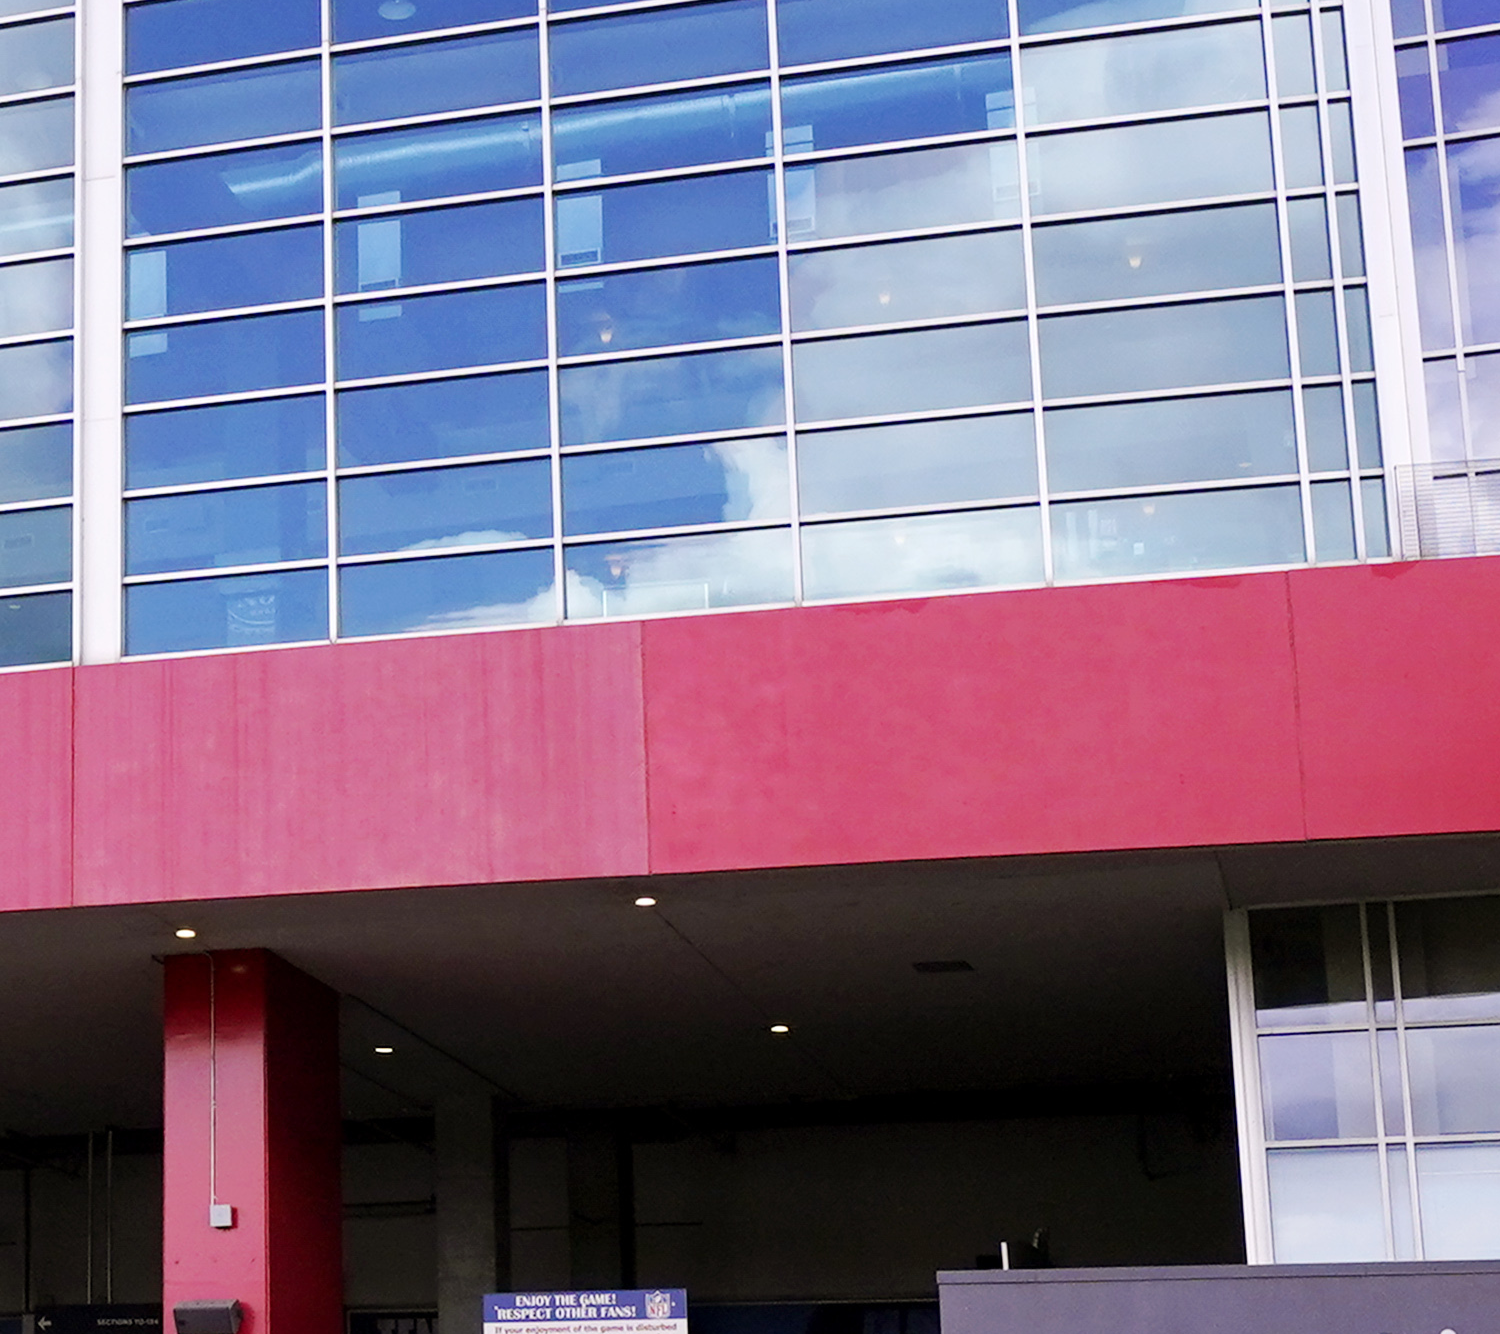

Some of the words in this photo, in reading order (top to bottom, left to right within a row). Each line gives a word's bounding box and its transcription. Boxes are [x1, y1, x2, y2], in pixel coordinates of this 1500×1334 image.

[515, 1295, 552, 1308] ENJOY
[555, 1294, 577, 1306] THE
[580, 1294, 616, 1307] GAME!
[497, 1307, 553, 1320] RESPECT
[556, 1306, 597, 1319] OTHER
[600, 1305, 636, 1318] FANS!
[525, 1326, 570, 1334] enjoyment
[600, 1326, 623, 1334] game
[636, 1323, 677, 1331] disturbed
